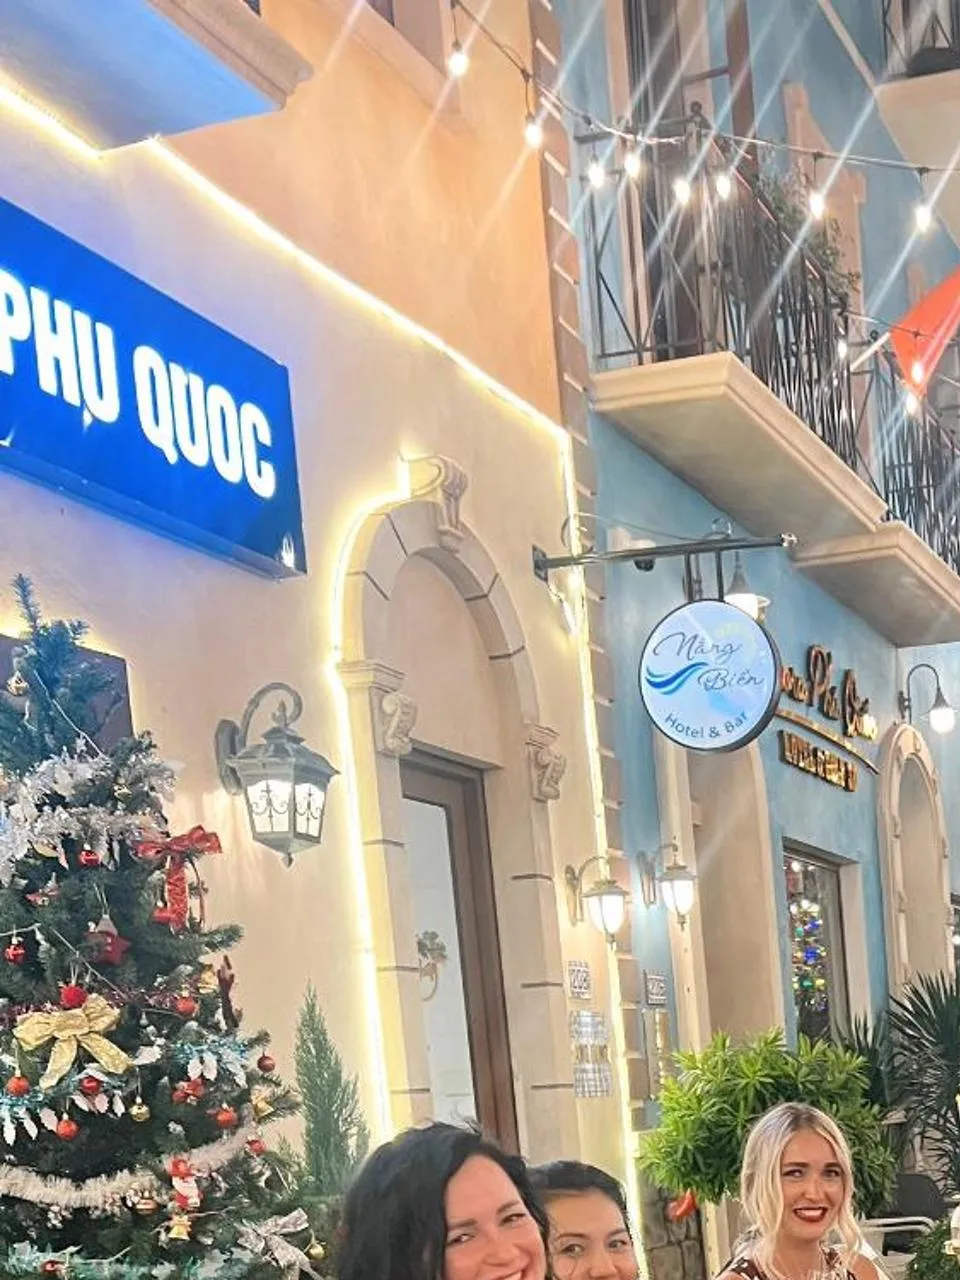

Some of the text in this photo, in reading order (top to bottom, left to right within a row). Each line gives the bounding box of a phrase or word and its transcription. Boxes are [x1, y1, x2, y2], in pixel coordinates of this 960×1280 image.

[664, 711, 748, 738] Hotel & Bar
